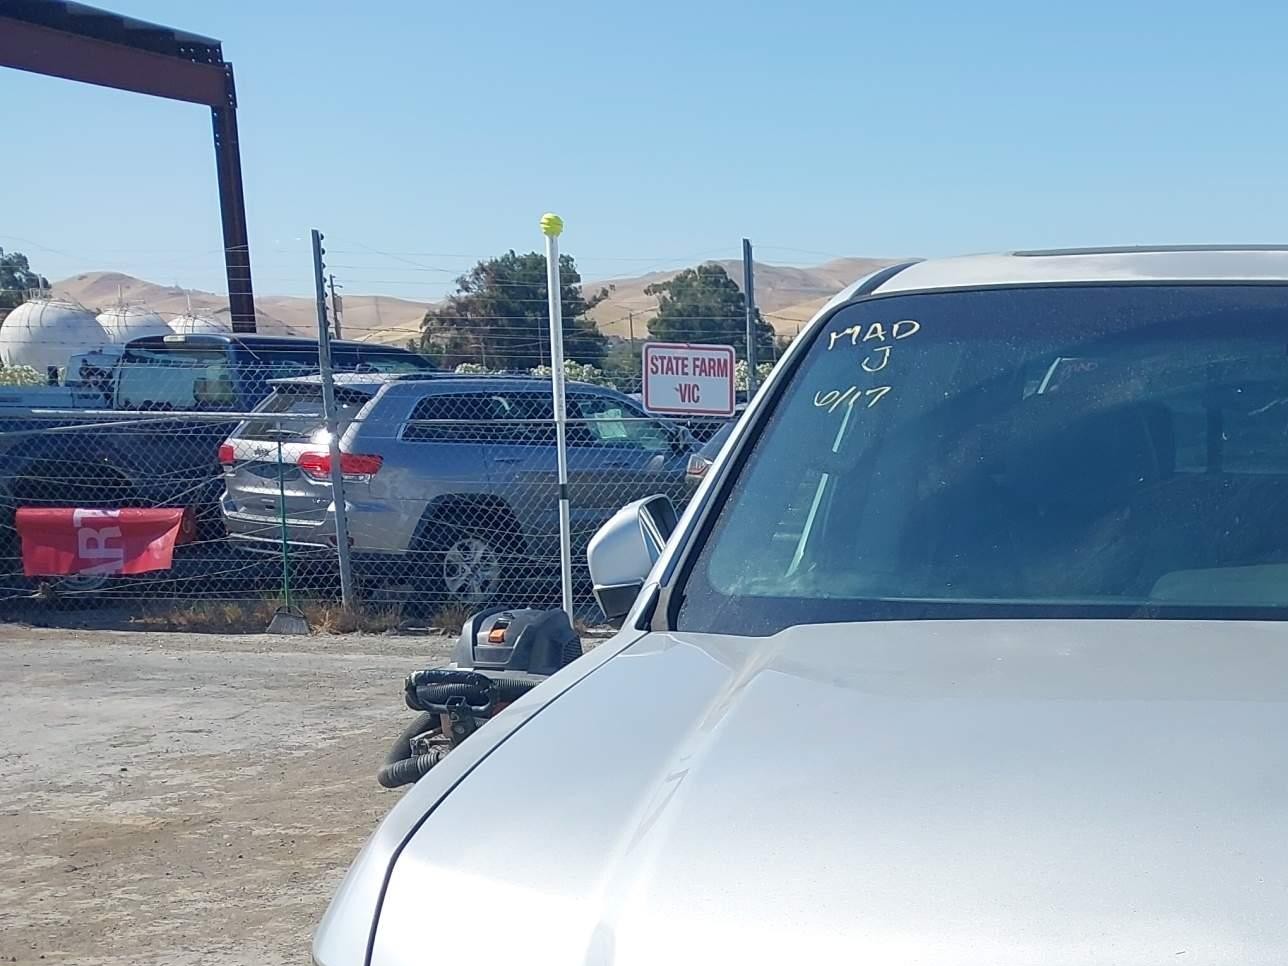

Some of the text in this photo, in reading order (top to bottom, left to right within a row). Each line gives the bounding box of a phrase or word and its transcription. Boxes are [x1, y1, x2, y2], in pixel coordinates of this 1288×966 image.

[828, 320, 921, 351] MAD
[650, 354, 729, 378] STATE FARM
[861, 345, 893, 372] J
[679, 383, 701, 403] VIC
